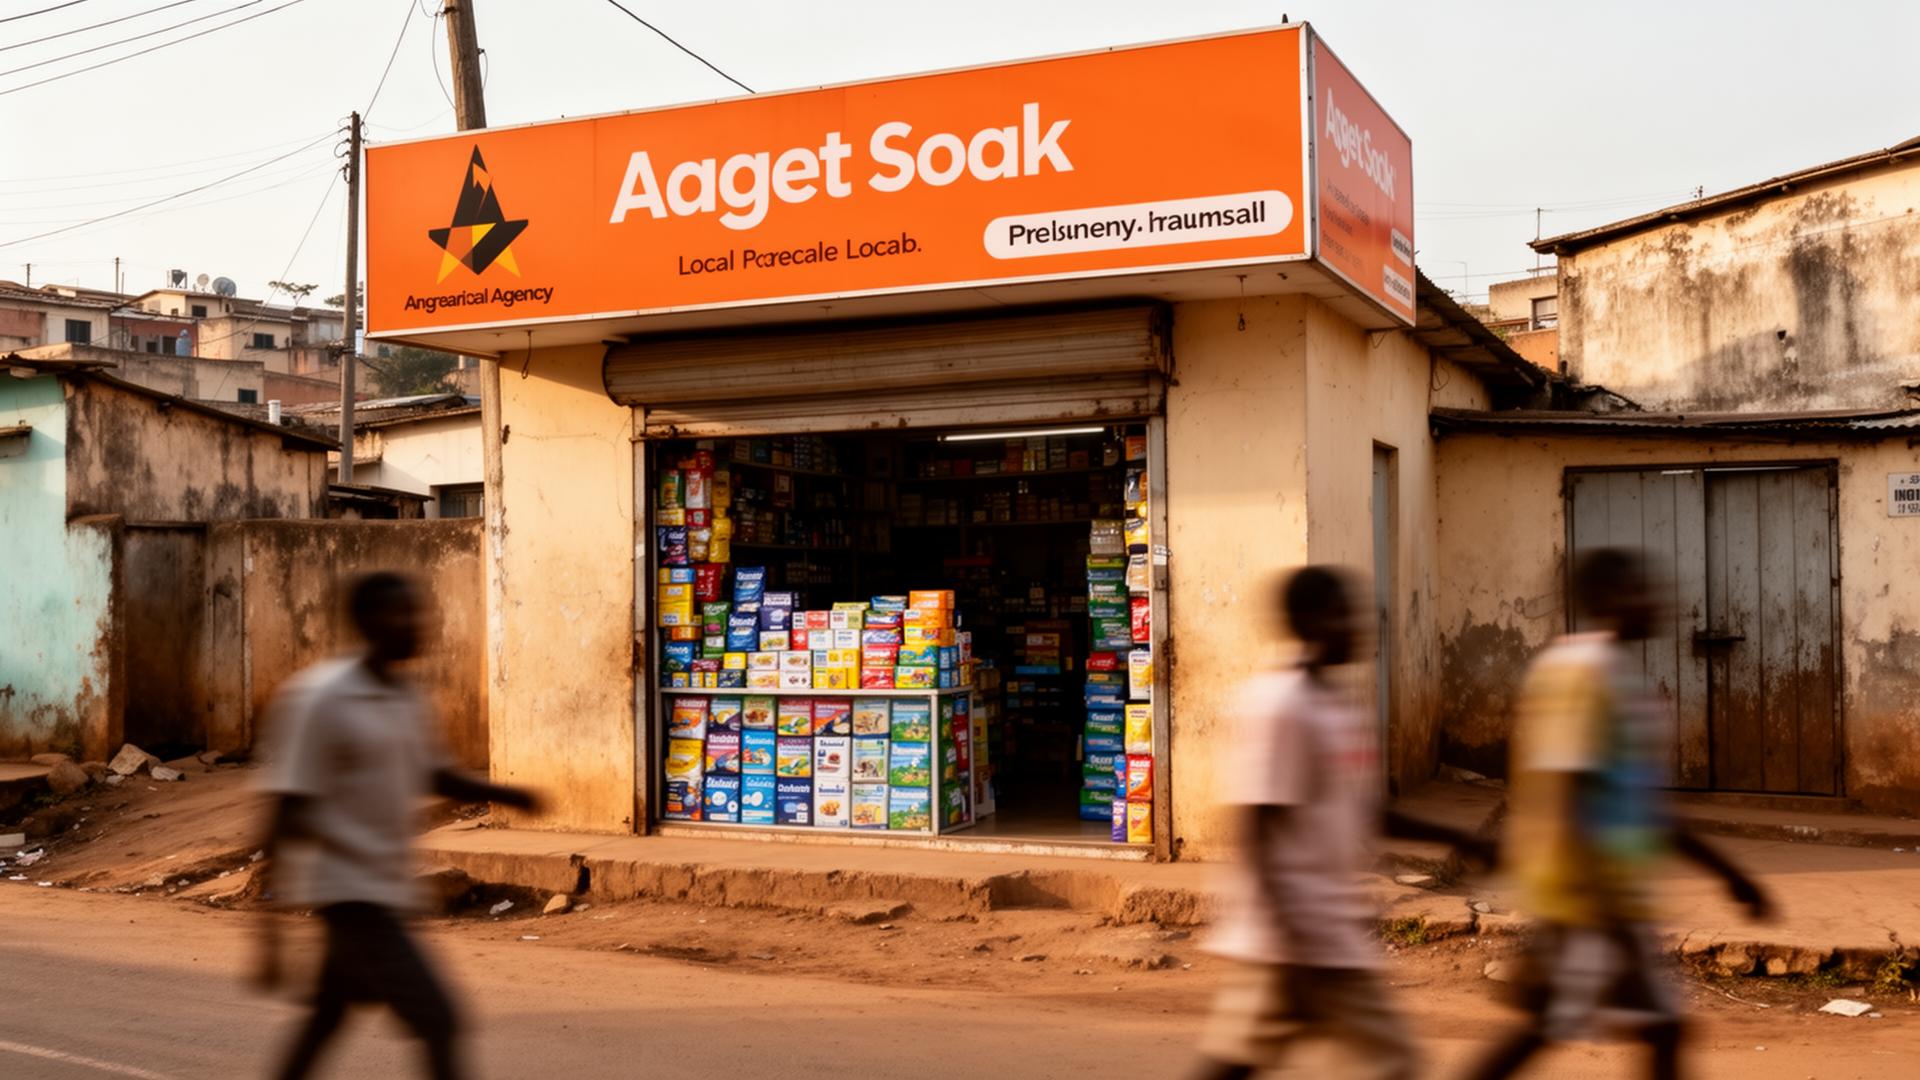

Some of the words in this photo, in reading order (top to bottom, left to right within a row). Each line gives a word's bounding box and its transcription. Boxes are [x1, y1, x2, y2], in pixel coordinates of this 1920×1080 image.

[609, 131, 852, 231] Aaget
[868, 102, 1075, 194] Soak
[679, 250, 735, 276] Local
[846, 232, 922, 259] Locab.
[490, 286, 554, 308] Agency
